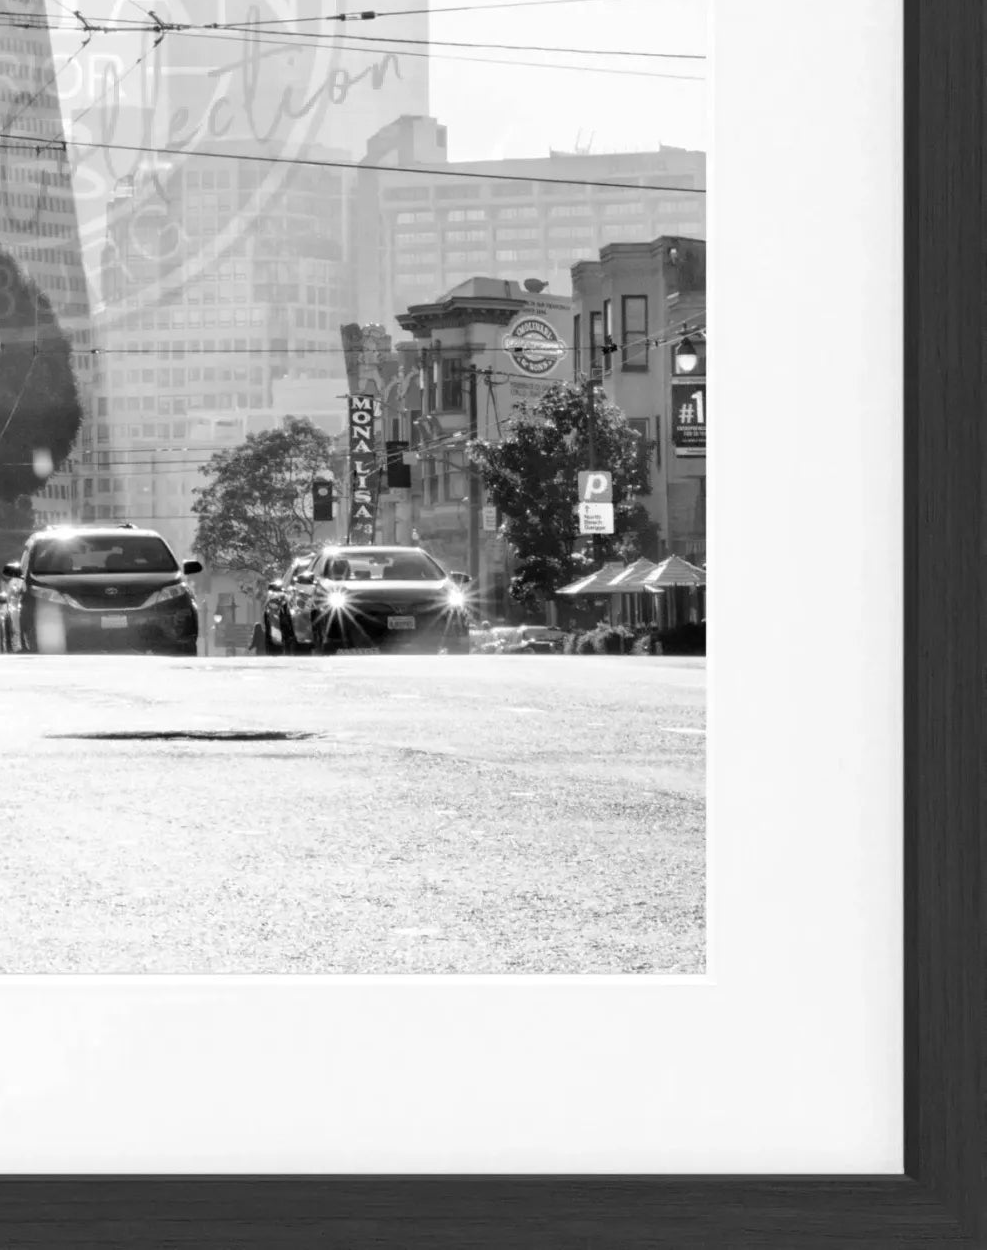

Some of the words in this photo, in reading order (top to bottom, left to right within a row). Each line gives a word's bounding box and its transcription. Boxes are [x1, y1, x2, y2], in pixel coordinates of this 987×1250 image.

[351, 397, 373, 453] MONA
[678, 390, 705, 424] #1
[354, 460, 373, 518] LISA
